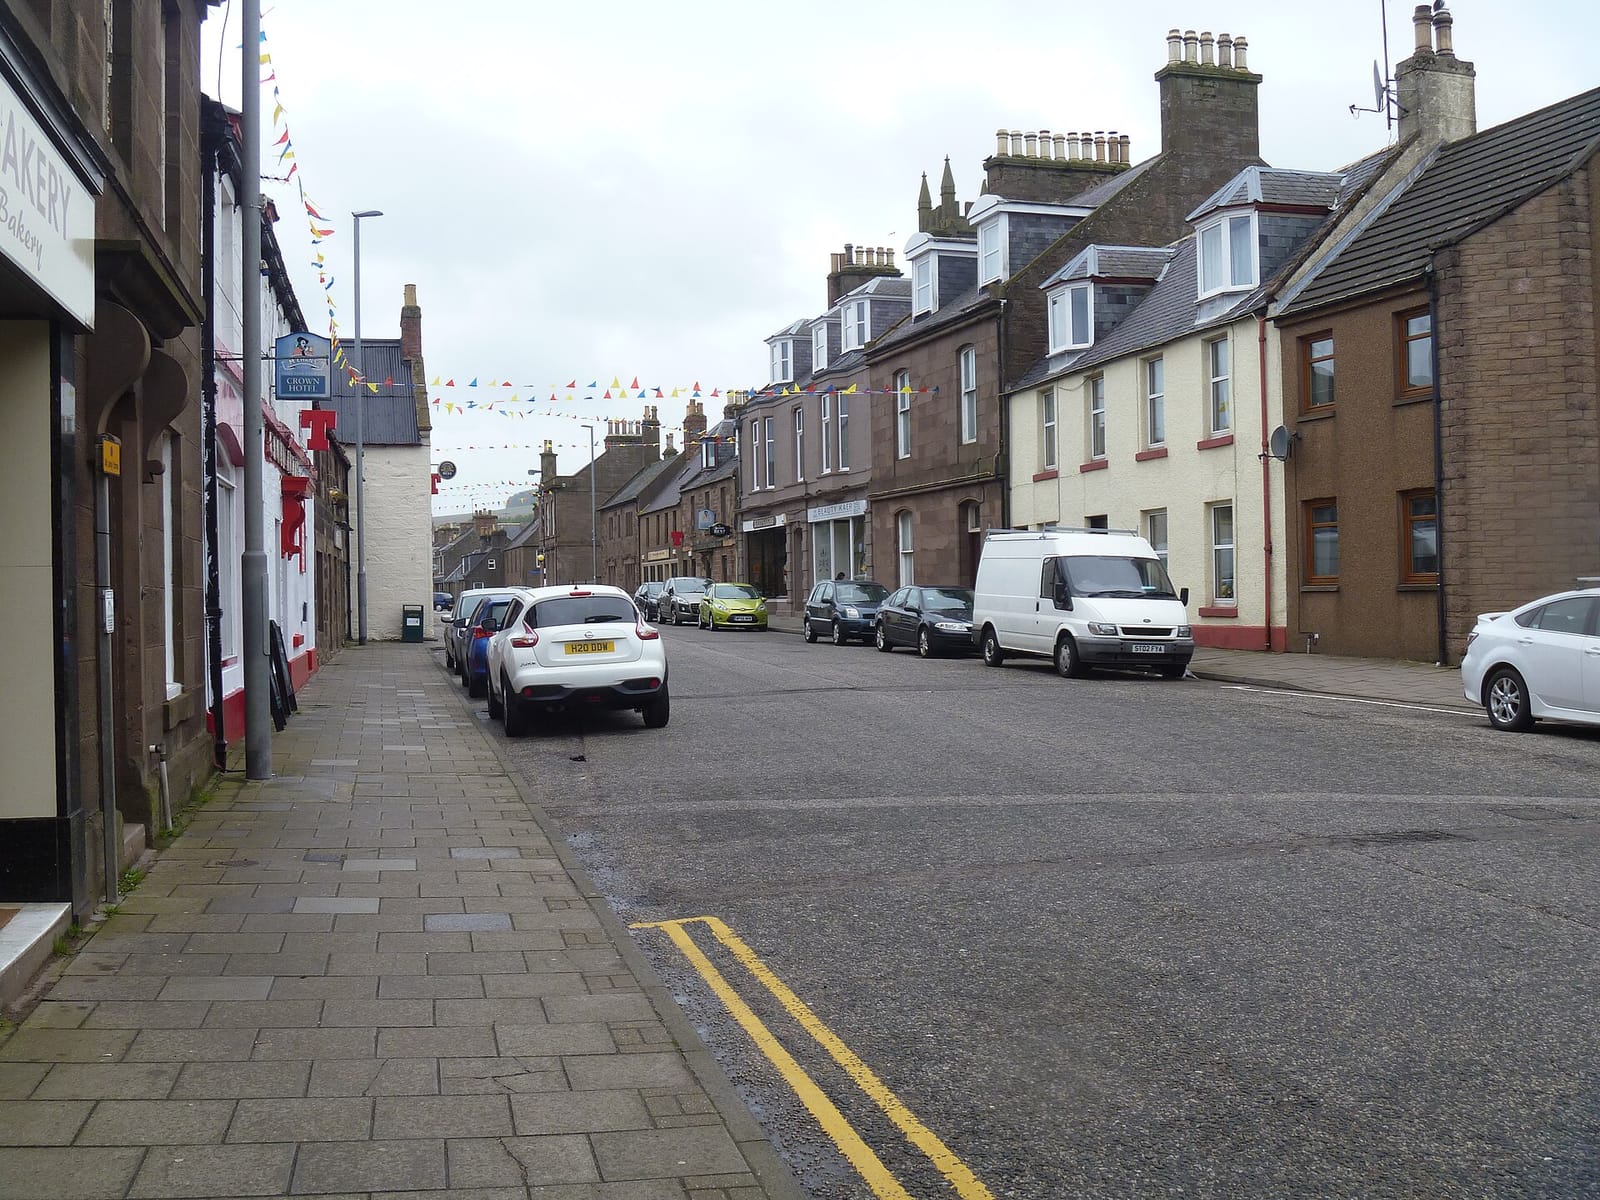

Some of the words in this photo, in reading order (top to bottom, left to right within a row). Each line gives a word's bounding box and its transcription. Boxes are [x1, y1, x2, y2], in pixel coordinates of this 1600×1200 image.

[0, 106, 71, 240] AKERY
[0, 185, 43, 272] Bakery
[286, 377, 320, 385] CROWN
[288, 384, 317, 392] HOTEL
[301, 410, 336, 450] T
